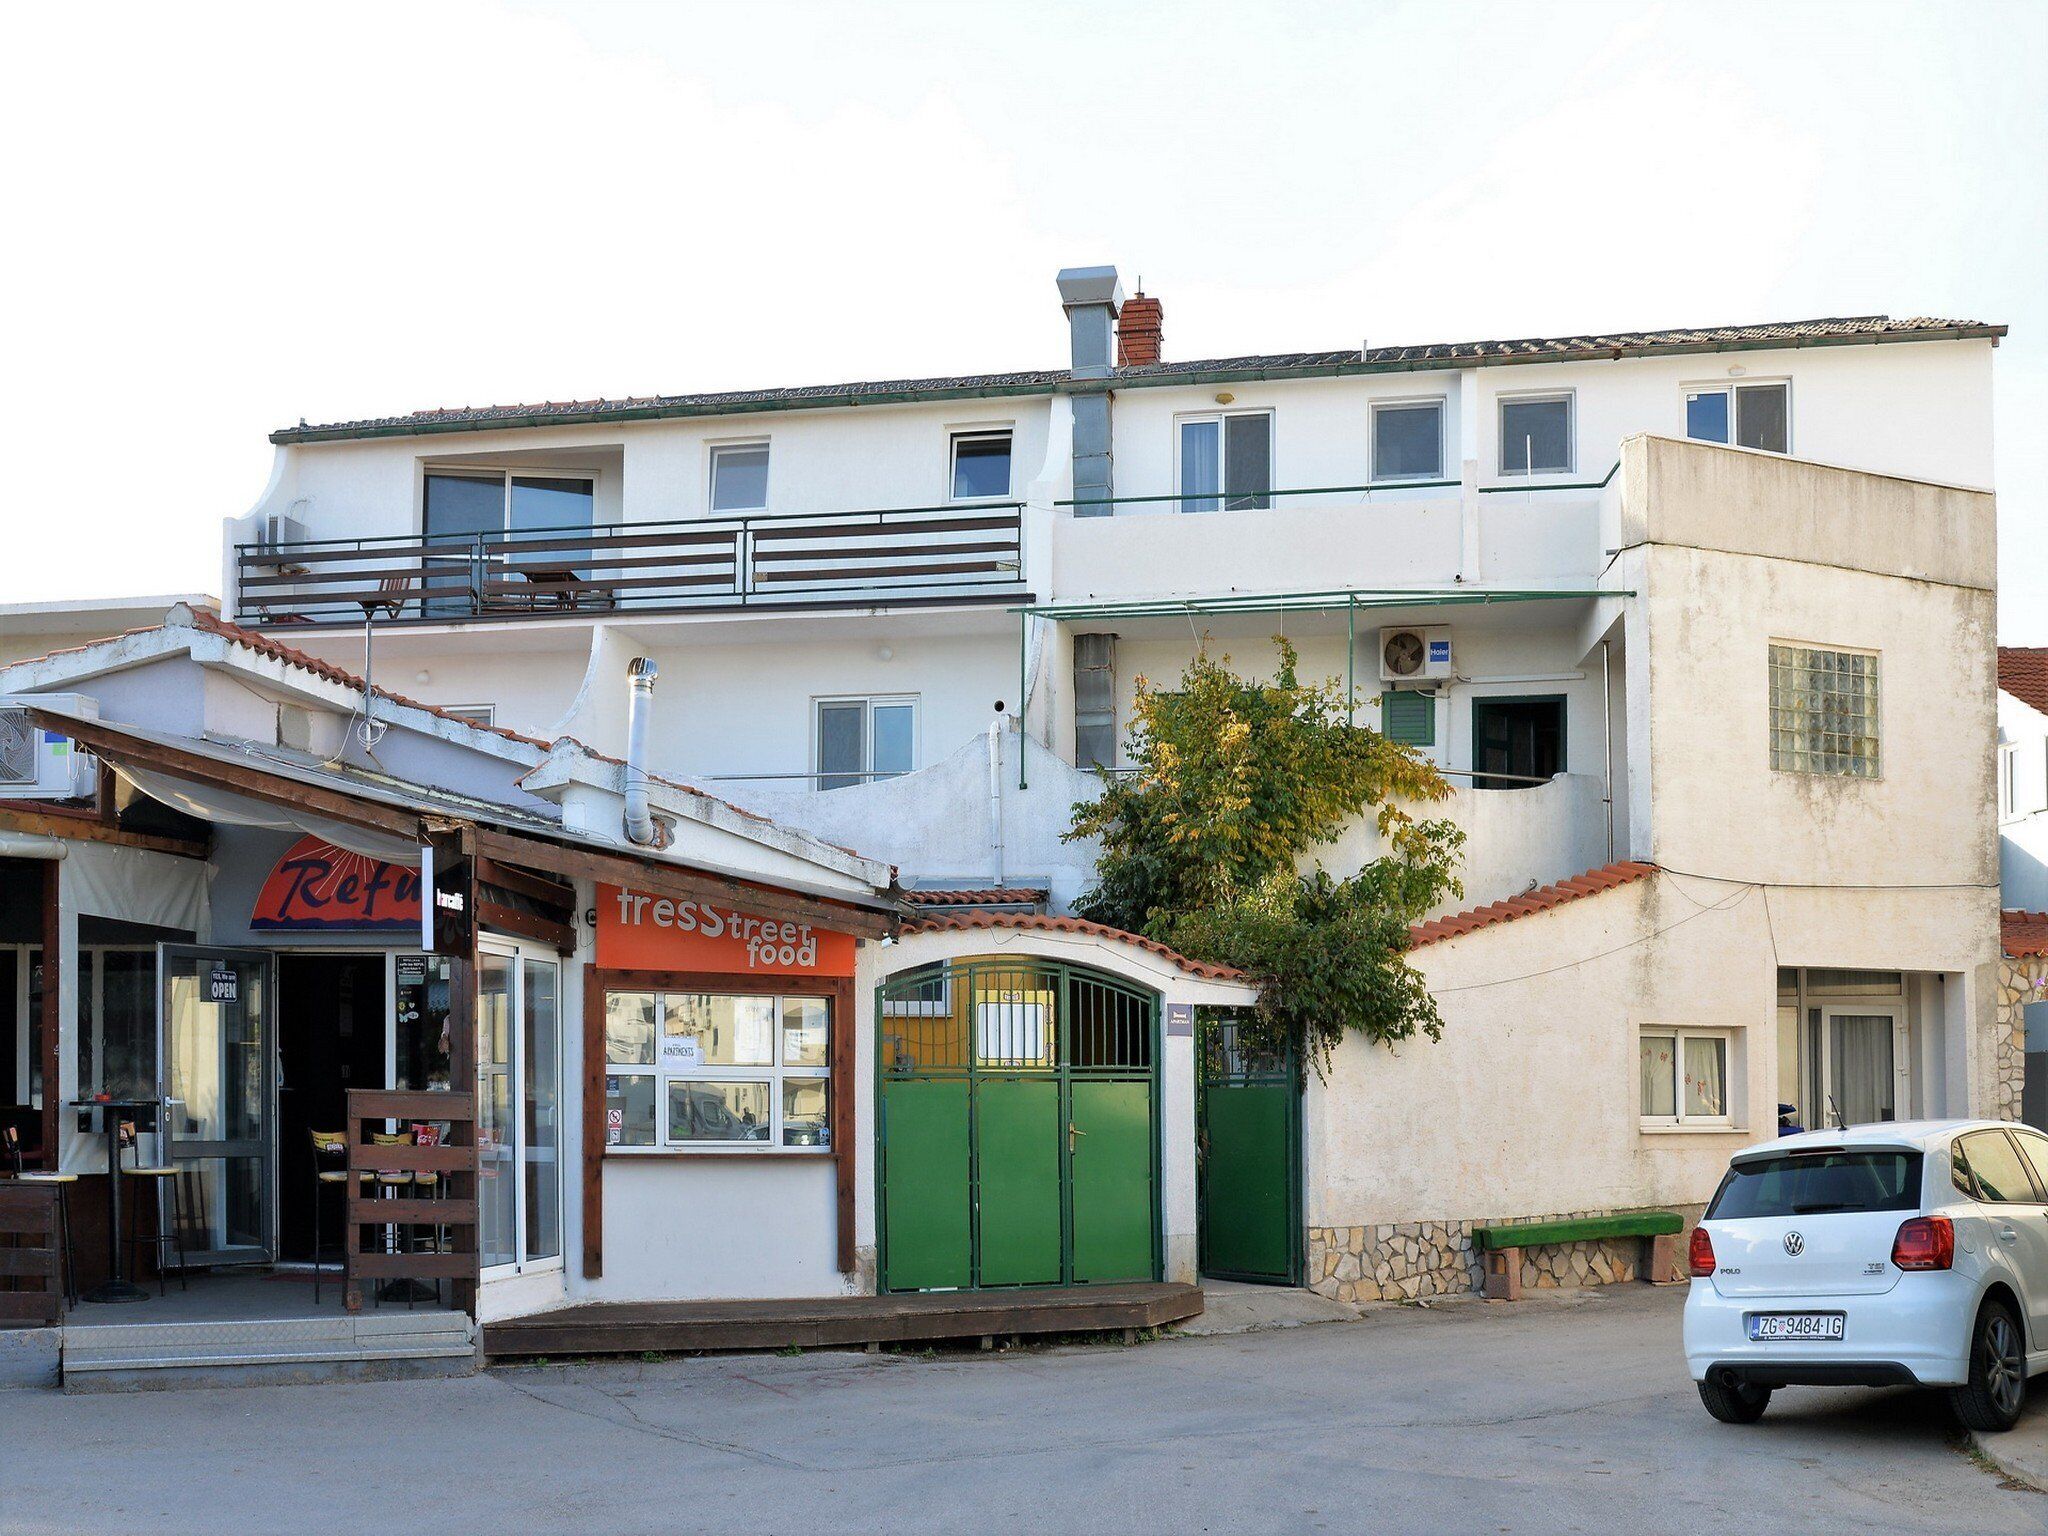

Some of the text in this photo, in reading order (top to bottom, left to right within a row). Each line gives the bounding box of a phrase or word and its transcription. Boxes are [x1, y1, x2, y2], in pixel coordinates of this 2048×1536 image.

[1430, 648, 1448, 656] Haier
[746, 935, 817, 968] food
[212, 981, 236, 998] OPEN
[1760, 1317, 1778, 1335] ZG
